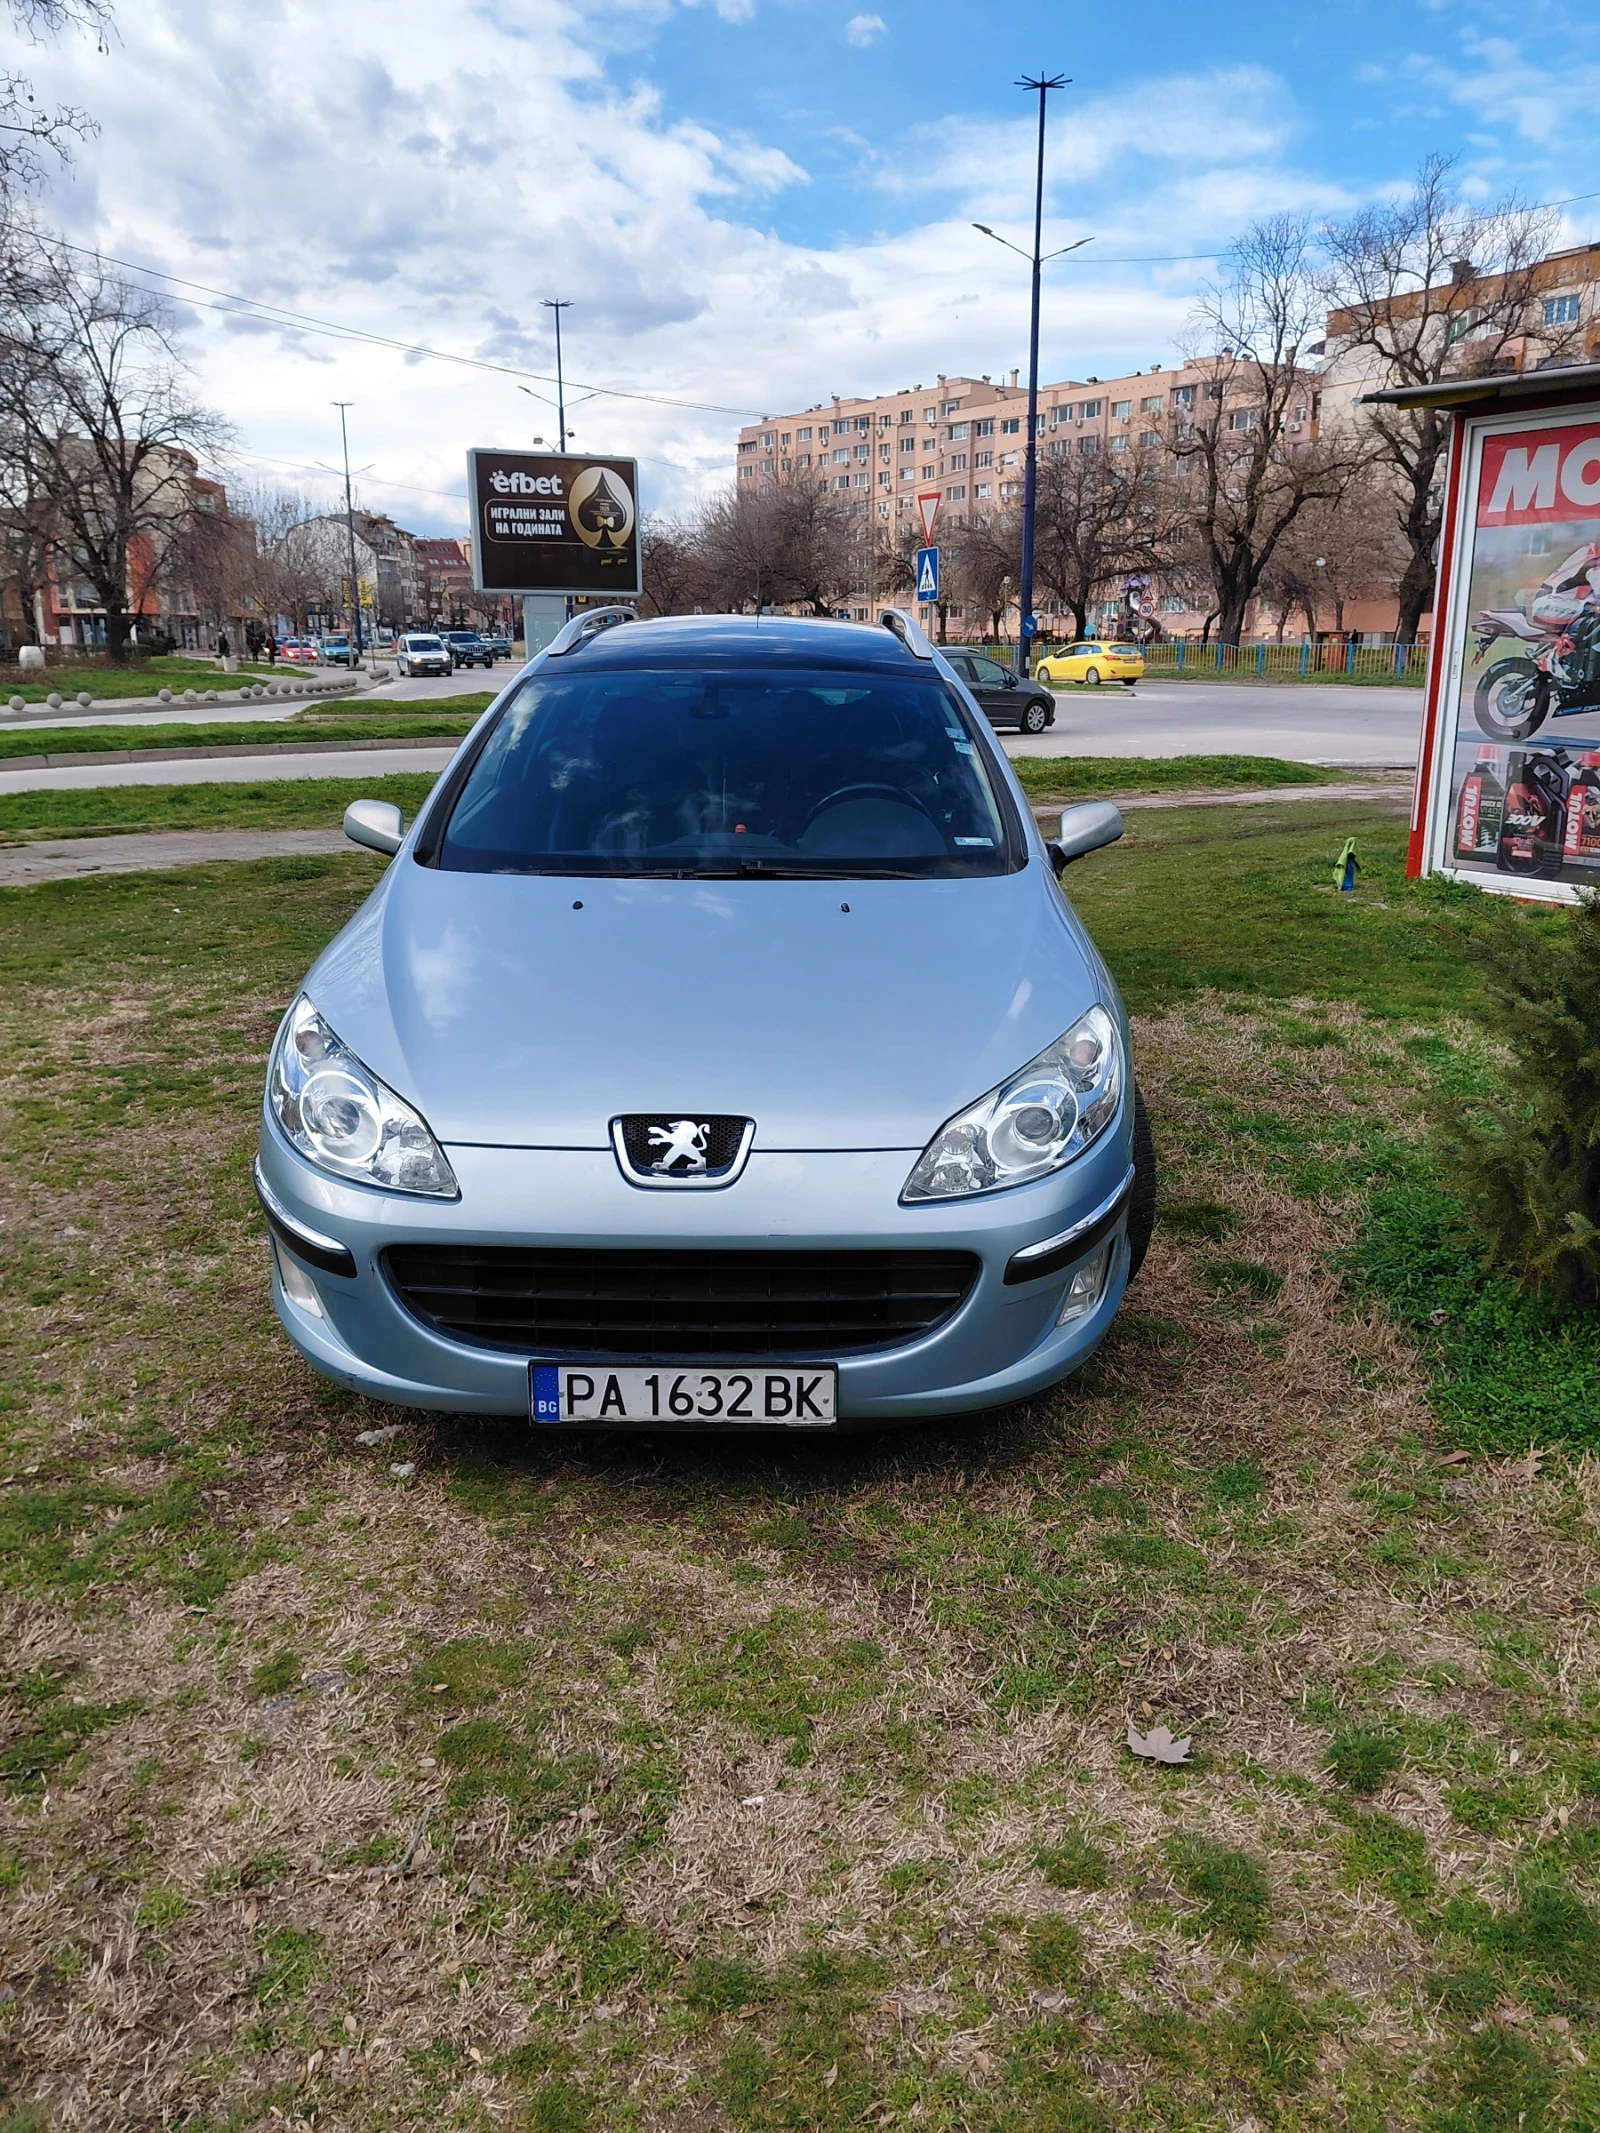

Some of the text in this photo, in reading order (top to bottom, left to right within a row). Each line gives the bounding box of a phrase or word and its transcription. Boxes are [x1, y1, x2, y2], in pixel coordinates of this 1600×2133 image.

[493, 471, 563, 495] efbet
[490, 507, 566, 521] ИГРАЛНИ ЗАЛИ
[495, 522, 563, 537] НА ГОДИНАТА
[1142, 605, 1151, 614] 30
[1461, 786, 1478, 847] MOTUL
[1505, 814, 1547, 826] 300V
[1565, 793, 1582, 850] MOTUL
[538, 1374, 824, 1417] BG PA 1632 BK
